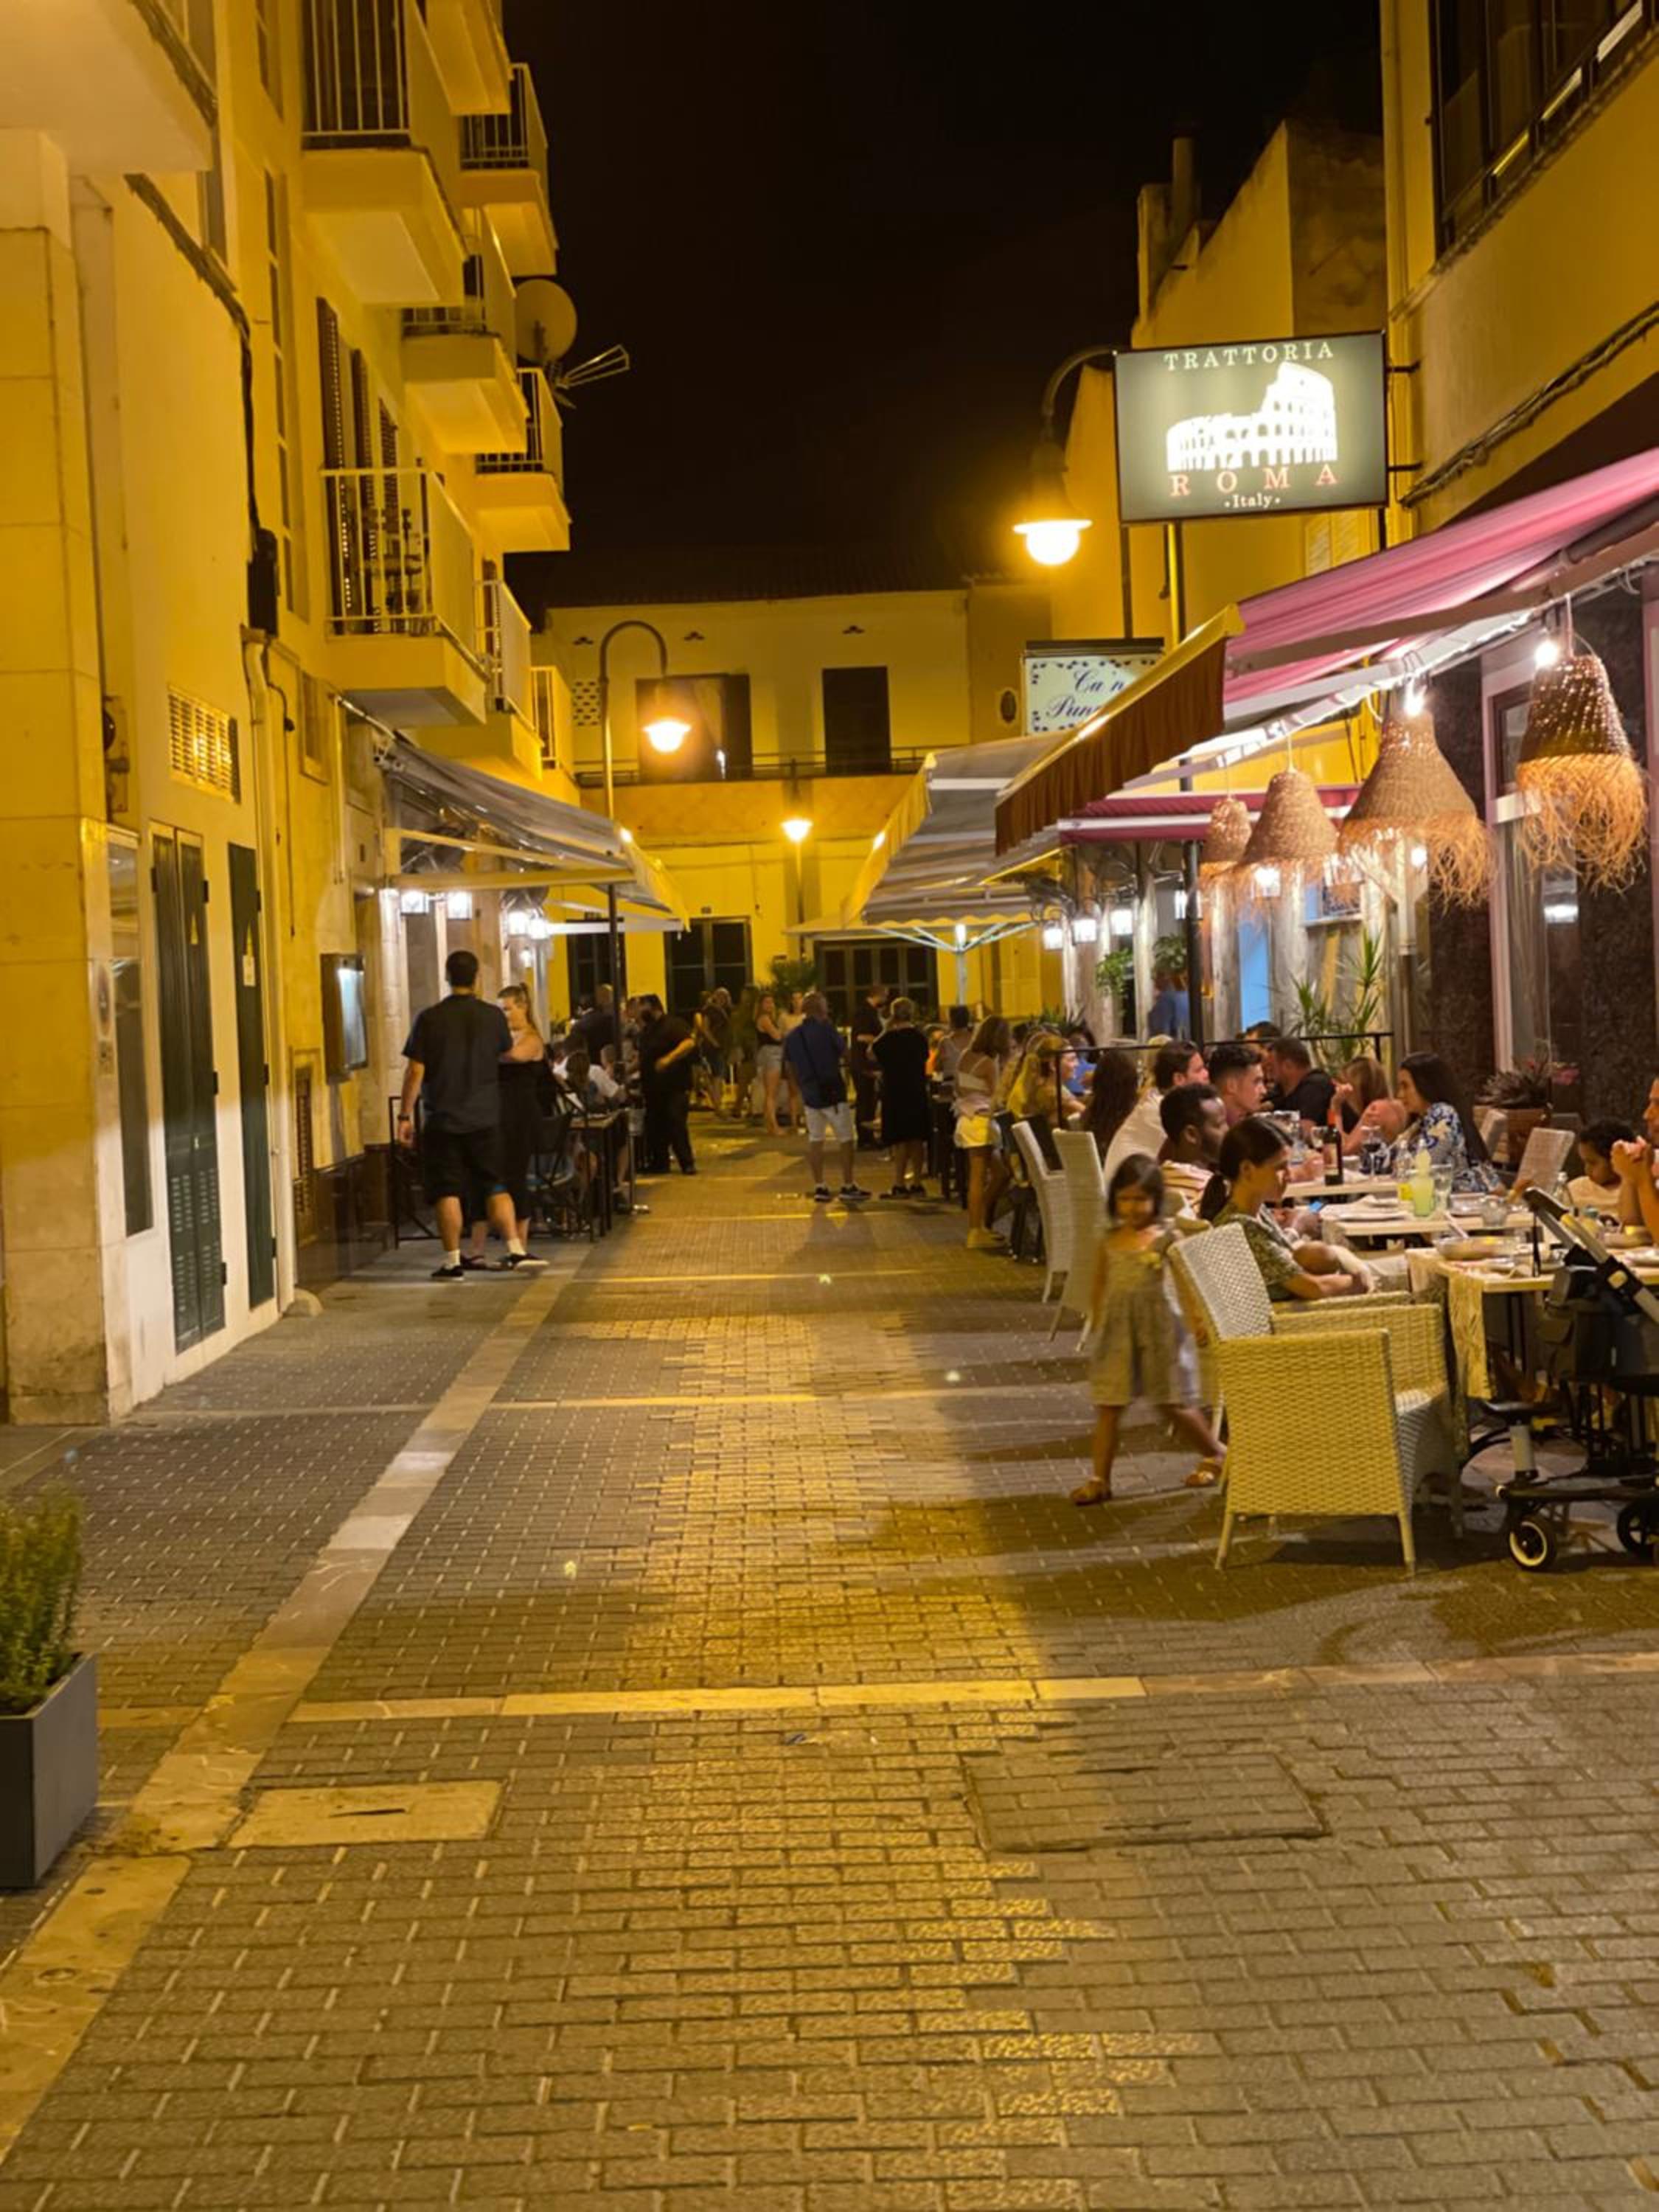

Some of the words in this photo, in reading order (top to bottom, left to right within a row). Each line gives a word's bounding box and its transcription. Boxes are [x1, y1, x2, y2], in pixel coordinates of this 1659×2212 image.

[1164, 342, 1333, 371] TRATTORIA
[1169, 463, 1339, 496] ROMA
[1046, 695, 1102, 718] Pun
